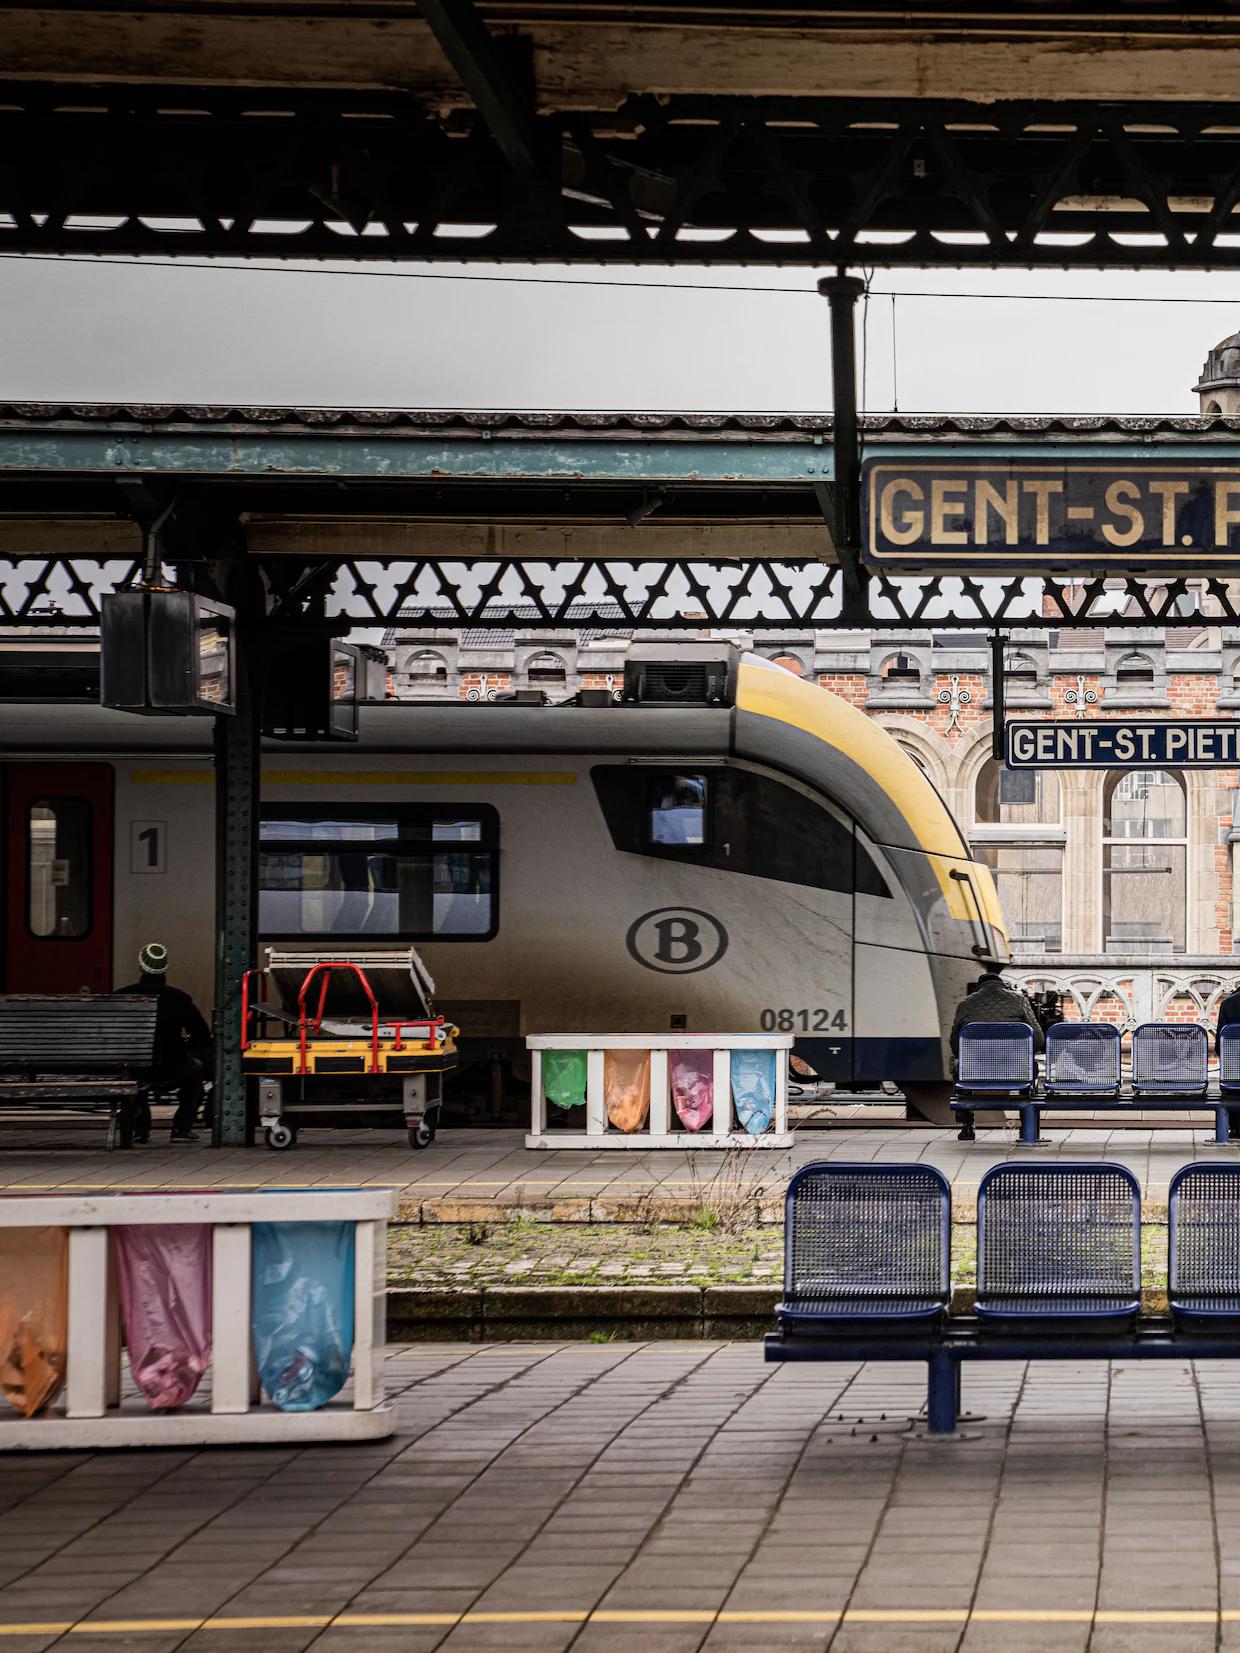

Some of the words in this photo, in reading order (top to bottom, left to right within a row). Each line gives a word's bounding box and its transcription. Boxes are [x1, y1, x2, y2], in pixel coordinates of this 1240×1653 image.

[880, 478, 1194, 548] GENT-ST.
[1013, 728, 1157, 761] GENT-ST.
[138, 828, 158, 867] 1
[723, 843, 731, 856] 1
[654, 918, 701, 963] B
[759, 1008, 849, 1033] 08124
